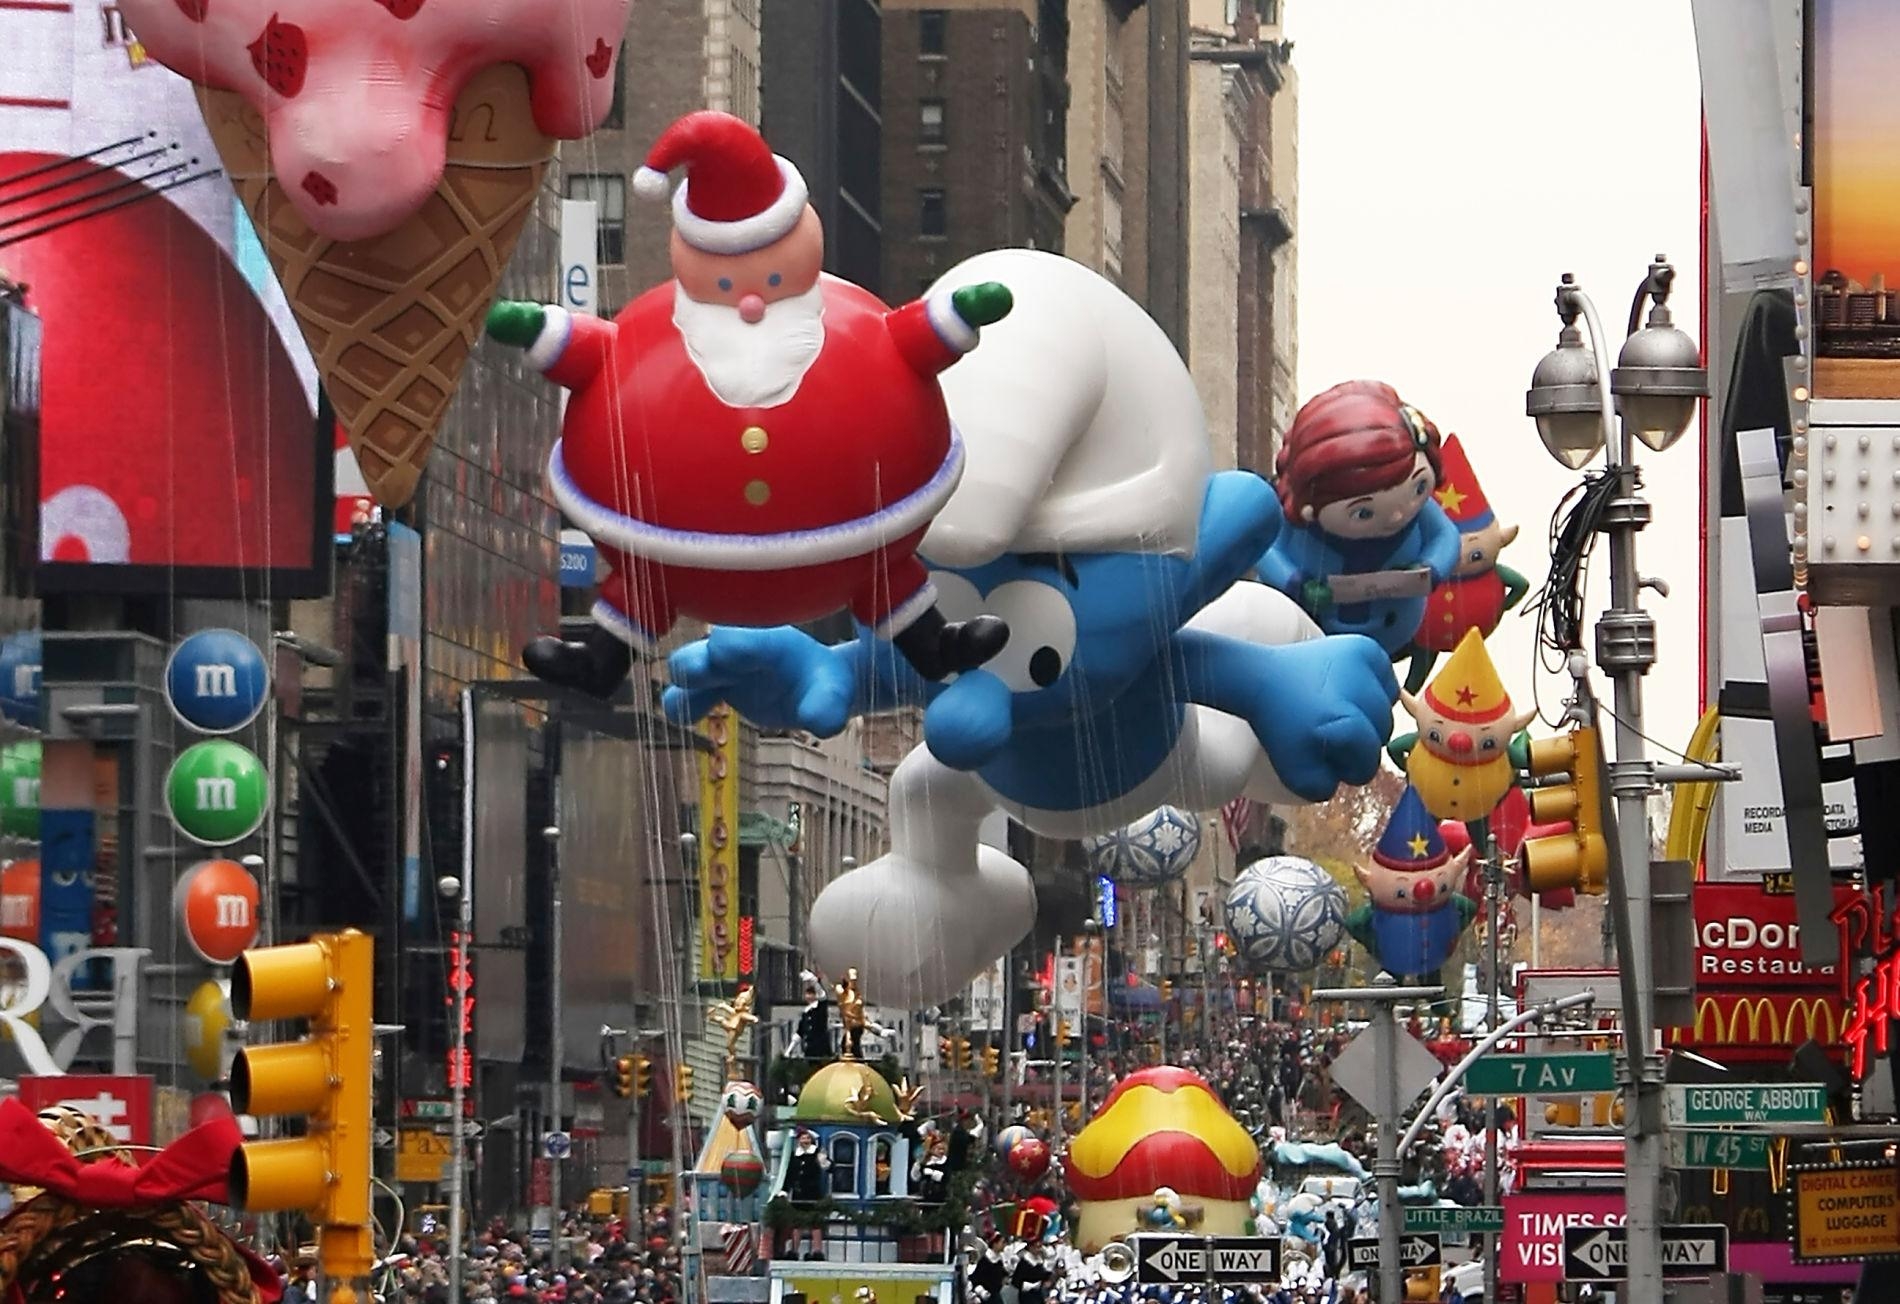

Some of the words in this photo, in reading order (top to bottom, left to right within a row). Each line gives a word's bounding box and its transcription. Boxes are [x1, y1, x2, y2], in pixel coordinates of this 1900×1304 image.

[196, 664, 236, 697] m
[196, 777, 236, 811] m
[1745, 822, 1773, 833] MEDIA
[216, 895, 250, 928] m
[1511, 1064, 1526, 1087] 7
[1538, 1063, 1576, 1087] Av
[1691, 1090, 1754, 1110] GEORGE
[1760, 1089, 1820, 1109] ABBOTT
[1744, 1110, 1769, 1121] WAY
[1693, 1135, 1709, 1164] W
[1715, 1136, 1742, 1165] 45
[1750, 1136, 1768, 1151] ST
[1802, 1176, 1847, 1192] DIGITAL
[1818, 1194, 1895, 1212] COMPUTERS
[1405, 1211, 1449, 1223] LITTLE
[1455, 1210, 1504, 1223] BRAZIL
[1826, 1215, 1888, 1230] LUGGAGE
[1161, 1252, 1200, 1269] ONE
[1220, 1252, 1262, 1269] WAY
[1360, 1248, 1379, 1261] ON
